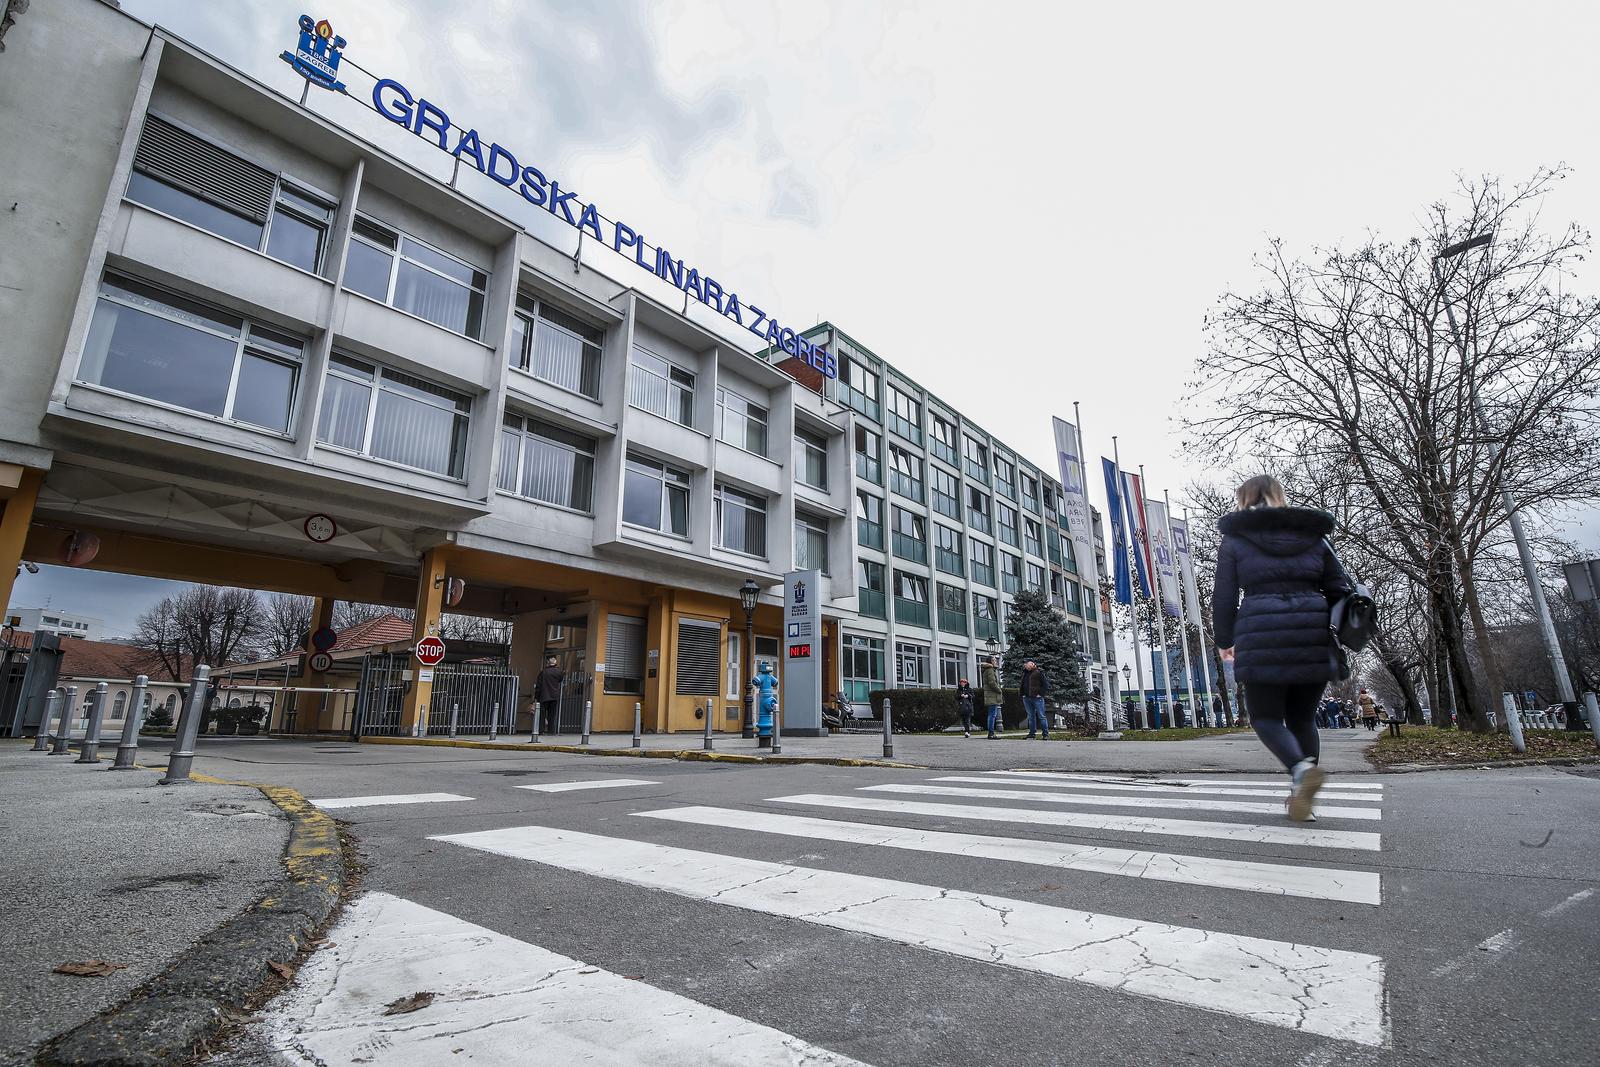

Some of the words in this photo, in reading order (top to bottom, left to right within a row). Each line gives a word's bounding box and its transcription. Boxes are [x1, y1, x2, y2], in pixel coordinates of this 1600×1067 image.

[300, 52, 335, 76] ZAGREB
[372, 78, 603, 242] GRADSKA
[614, 221, 743, 326] PLINARA
[749, 305, 837, 379] ZAGREB
[418, 644, 443, 657] STOP
[790, 647, 800, 657] NI
[315, 657, 327, 669] 10
